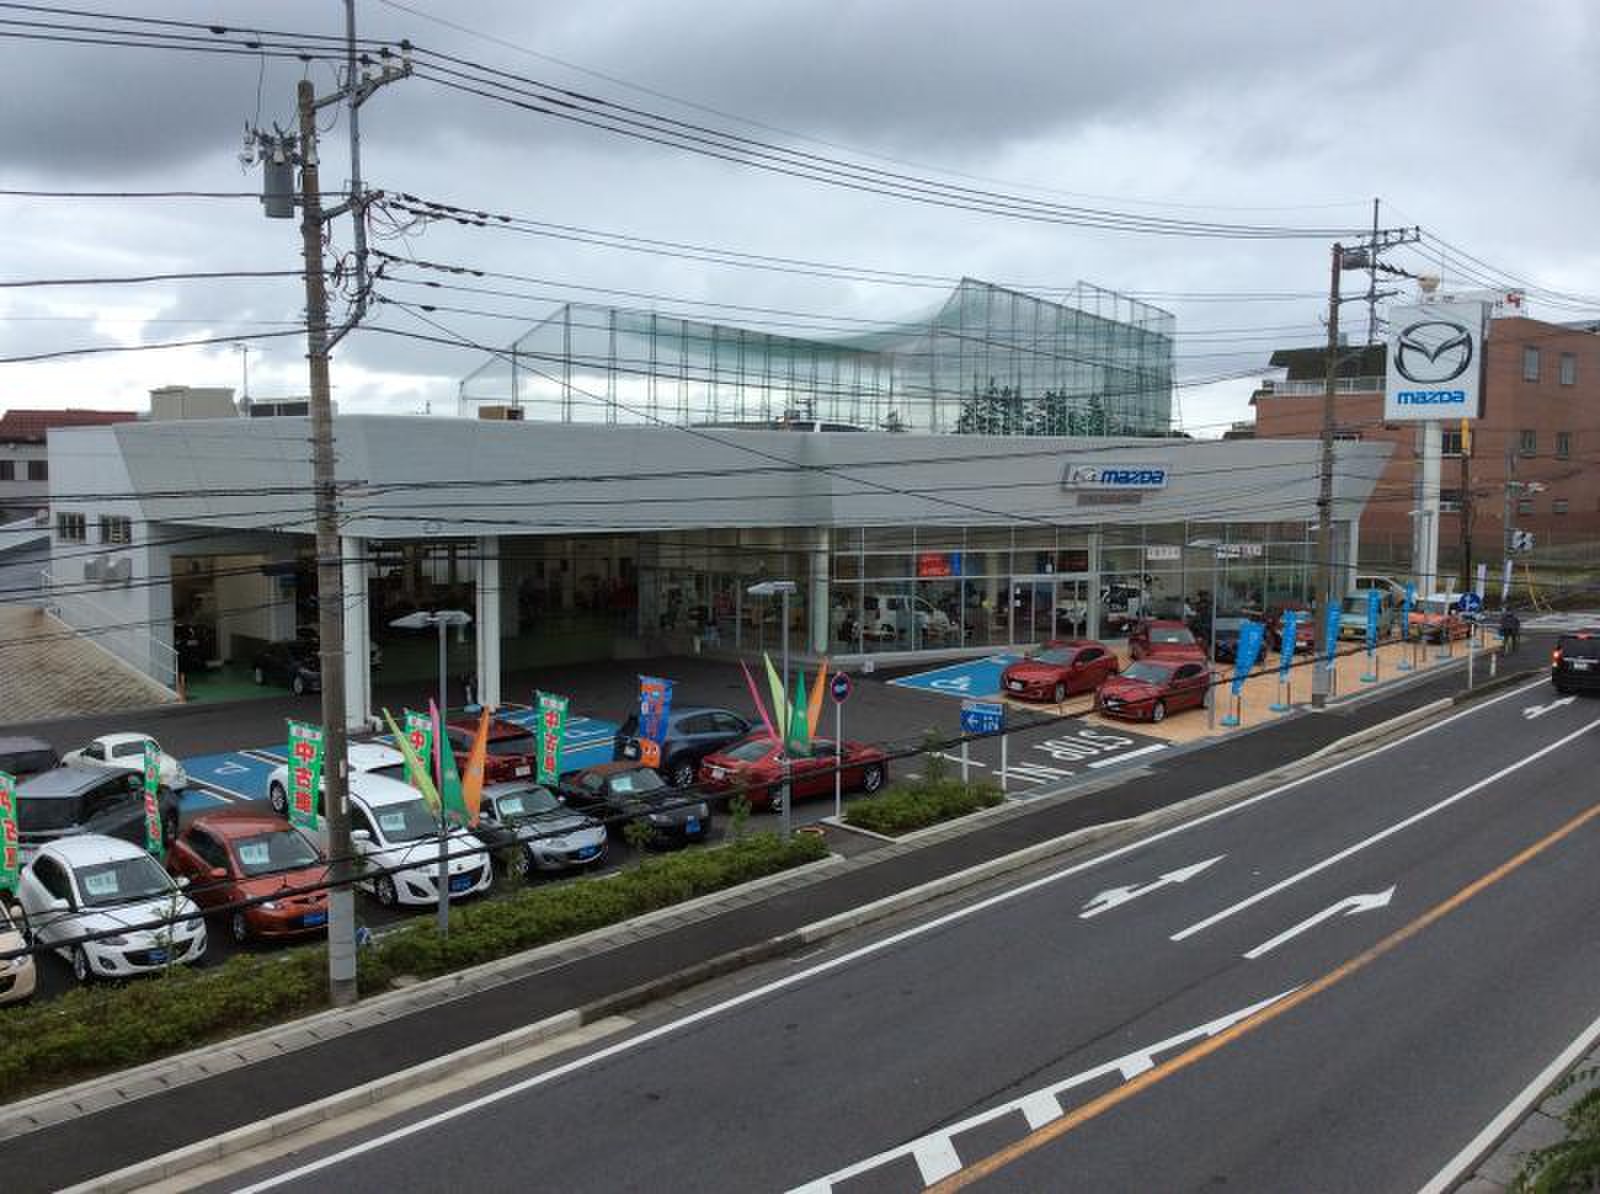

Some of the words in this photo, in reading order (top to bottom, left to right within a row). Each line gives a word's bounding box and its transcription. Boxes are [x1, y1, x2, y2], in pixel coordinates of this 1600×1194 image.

[1397, 391, 1466, 405] mazda
[1101, 469, 1165, 485] mazda
[982, 715, 1000, 731] IN
[1032, 729, 1134, 761] STOP
